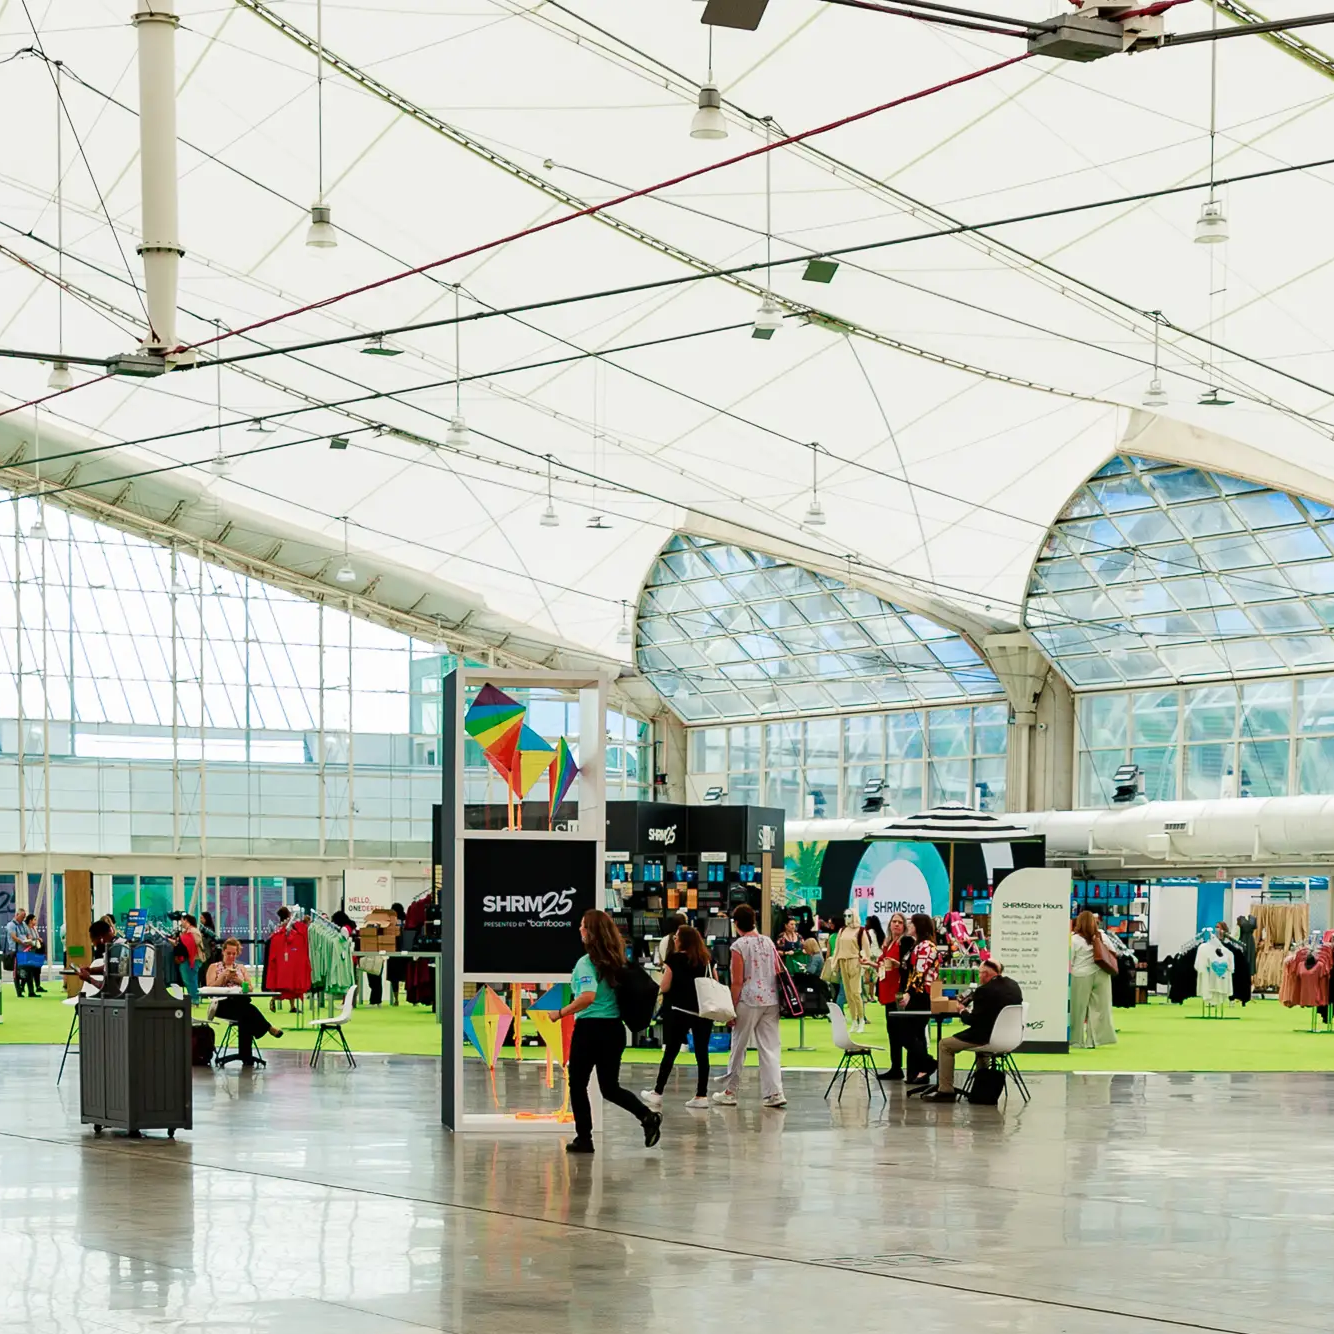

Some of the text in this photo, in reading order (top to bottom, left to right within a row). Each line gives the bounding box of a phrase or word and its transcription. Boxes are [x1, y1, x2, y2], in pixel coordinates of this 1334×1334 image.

[648, 825, 677, 846] SHRM25
[854, 887, 874, 898] 13 14
[349, 896, 371, 904] HELLO,
[482, 886, 577, 919] SHRM25
[874, 901, 925, 914] SHRMStore
[527, 919, 572, 928] bambooHR
